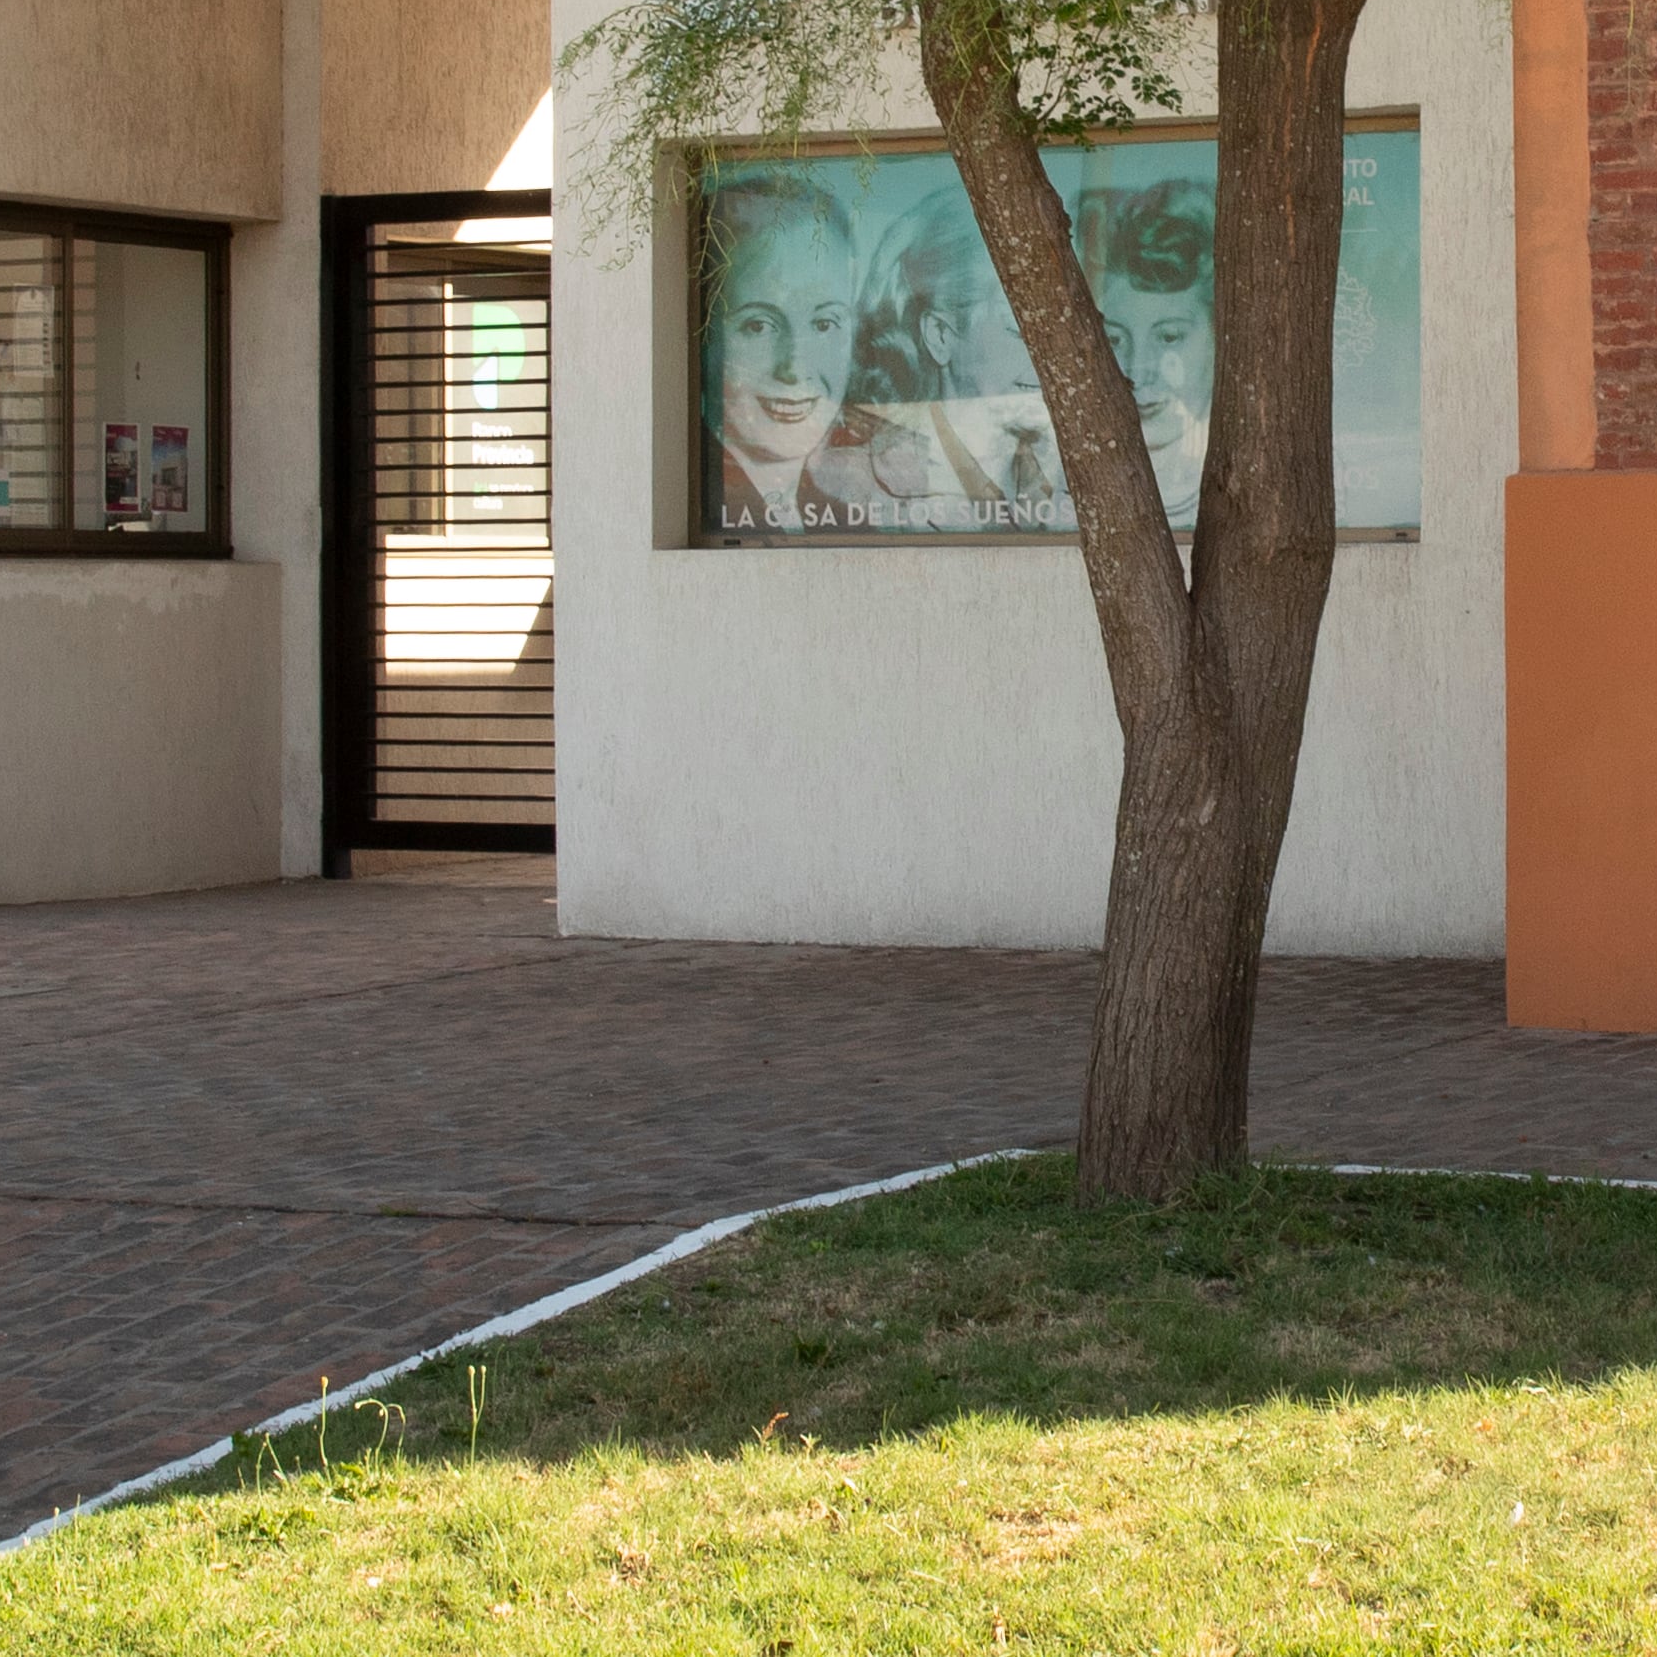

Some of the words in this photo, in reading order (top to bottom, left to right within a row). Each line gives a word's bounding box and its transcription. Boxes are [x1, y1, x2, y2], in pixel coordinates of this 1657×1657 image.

[721, 503, 755, 528] LA
[764, 502, 838, 527] CSA
[847, 501, 884, 526] DE
[894, 500, 946, 525] LOS
[959, 494, 1075, 525] SUEÑOS
